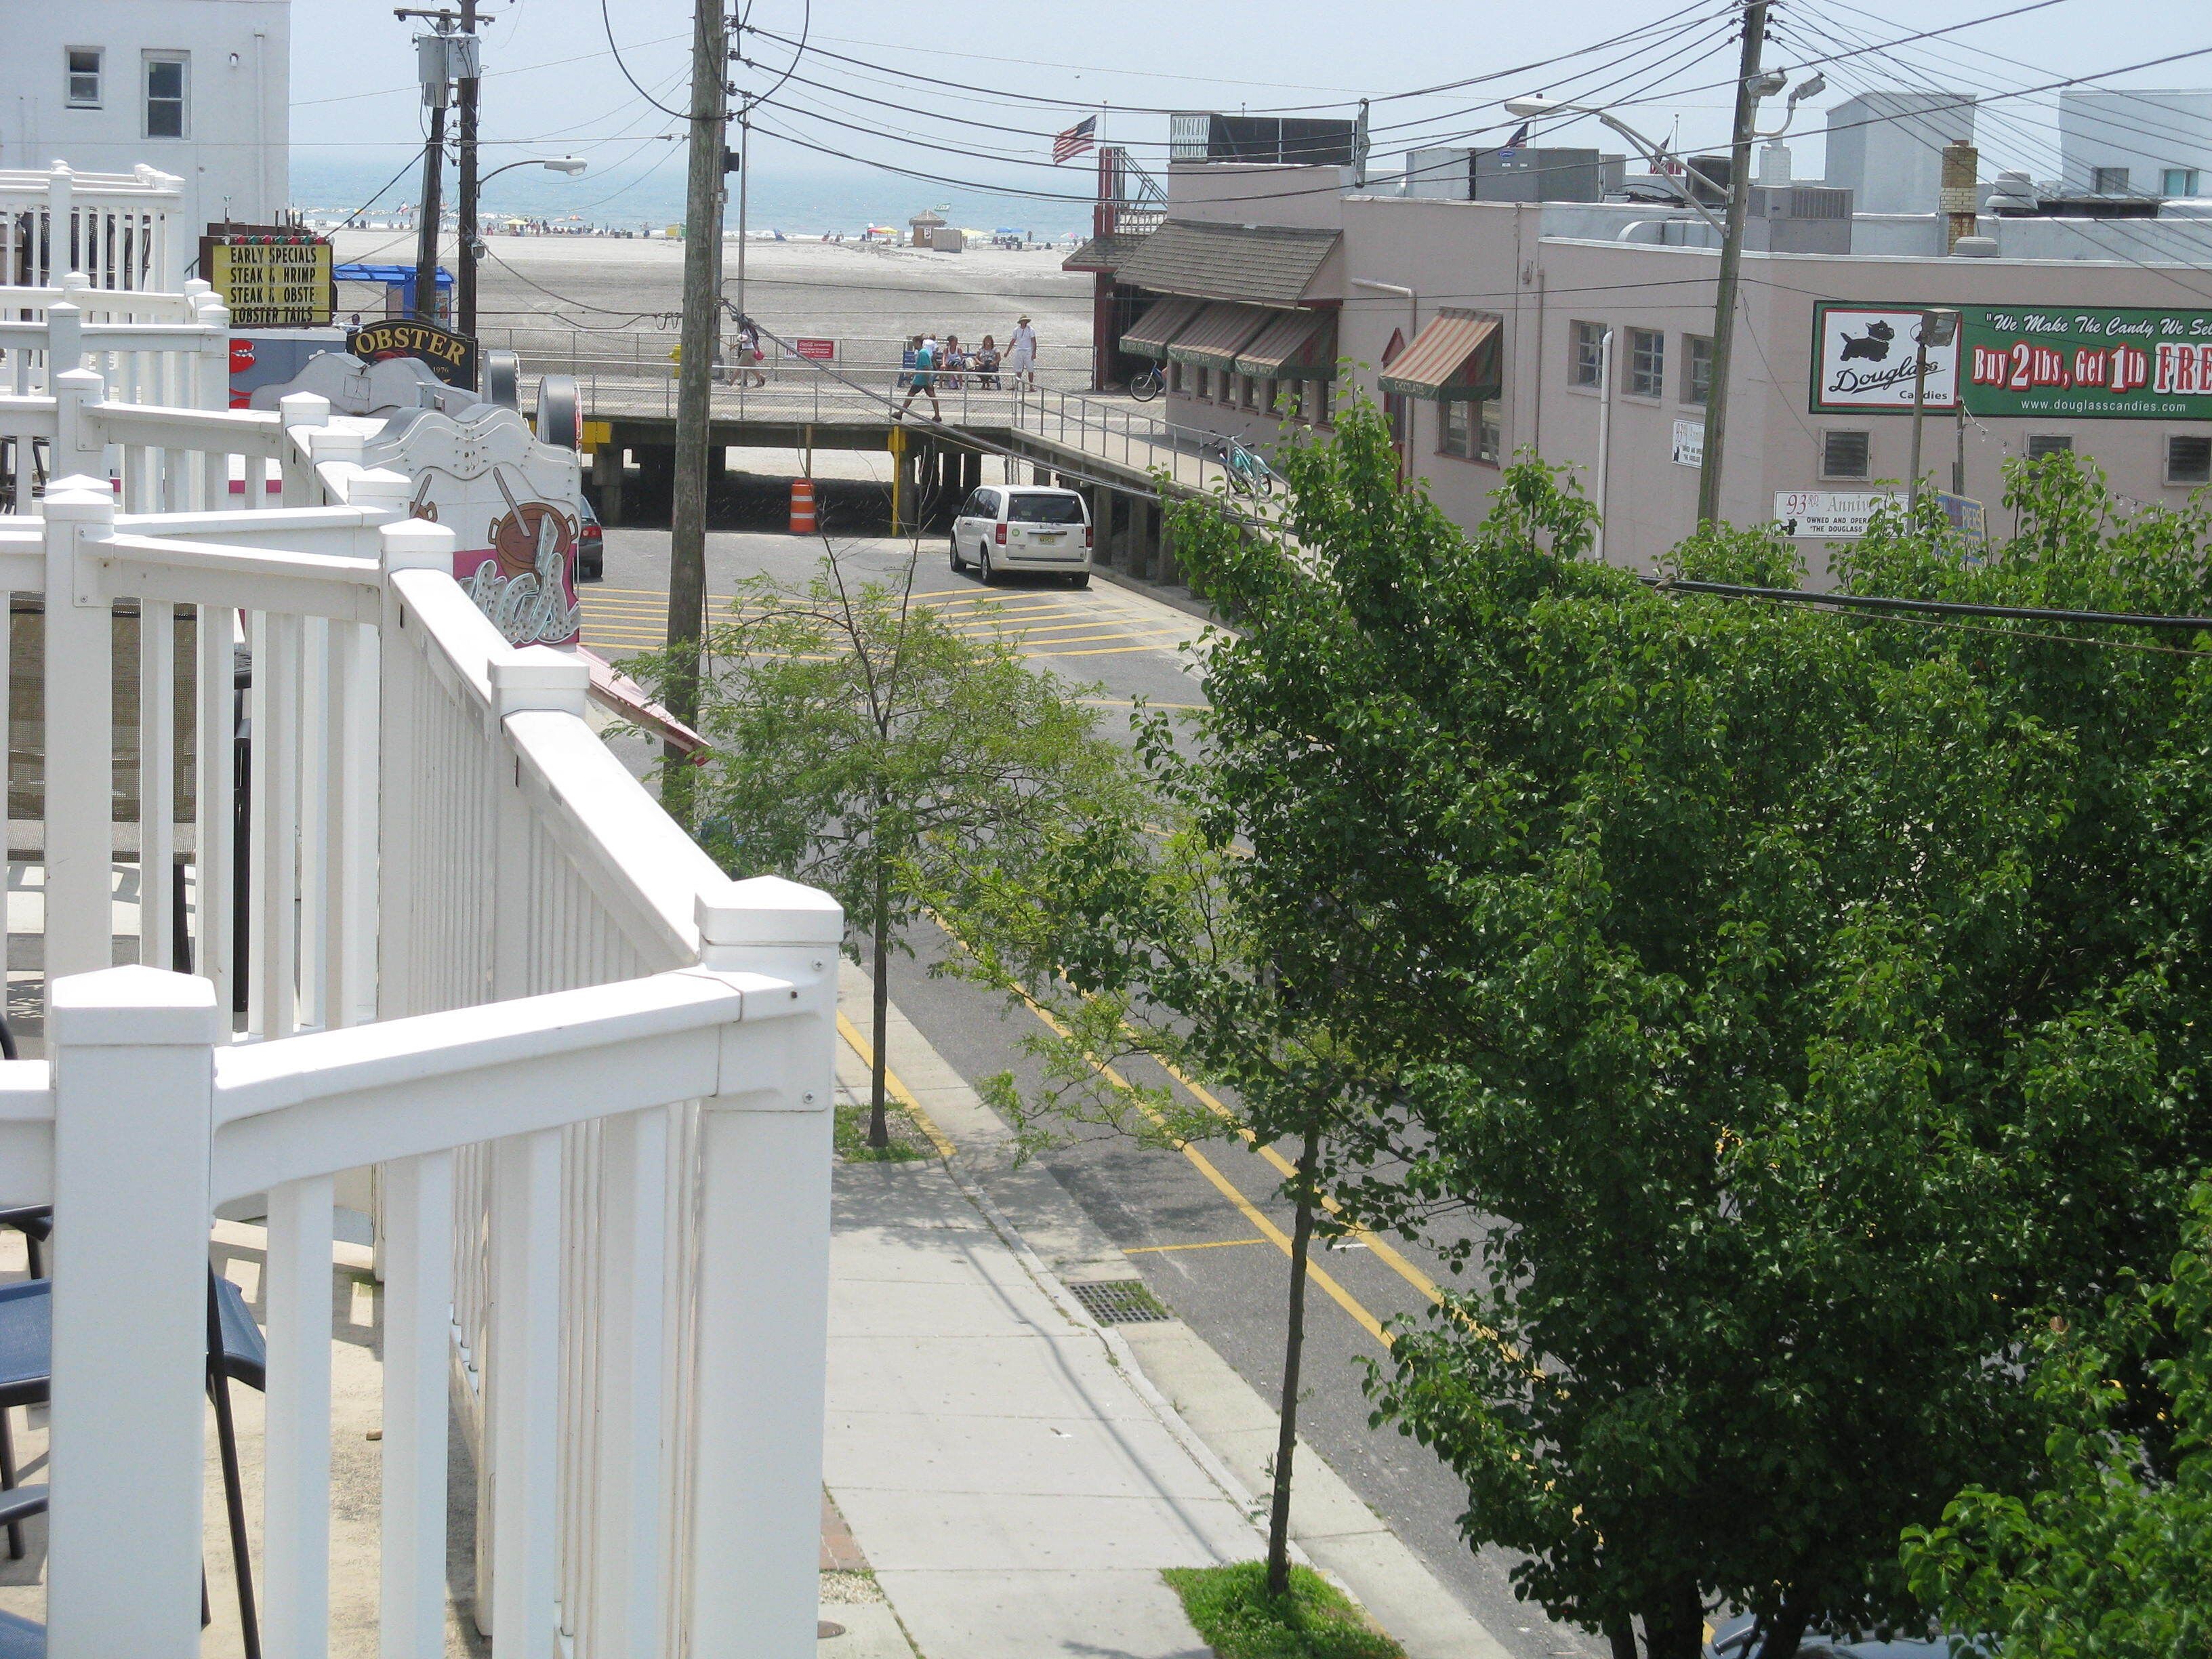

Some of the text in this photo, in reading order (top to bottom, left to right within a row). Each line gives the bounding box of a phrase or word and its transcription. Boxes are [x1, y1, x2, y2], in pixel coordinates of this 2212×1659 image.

[231, 247, 316, 263] EARLY SPECIALS
[230, 267, 263, 283] STEAK
[284, 267, 316, 283] HRIMP
[230, 287, 263, 304] STEAK
[284, 287, 314, 302] OBSTE
[232, 306, 313, 324] LOBSTER TAILS
[2024, 314, 2068, 333] Make
[2074, 315, 2101, 333] The
[2106, 316, 2154, 338] Candy
[2160, 318, 2184, 335] We
[355, 327, 466, 367] OBSTER
[1972, 348, 2007, 386] Buy
[2075, 350, 2104, 384] Get
[1899, 390, 1948, 400] Cadies
[2021, 398, 2186, 413] www.douglasscandies.com
